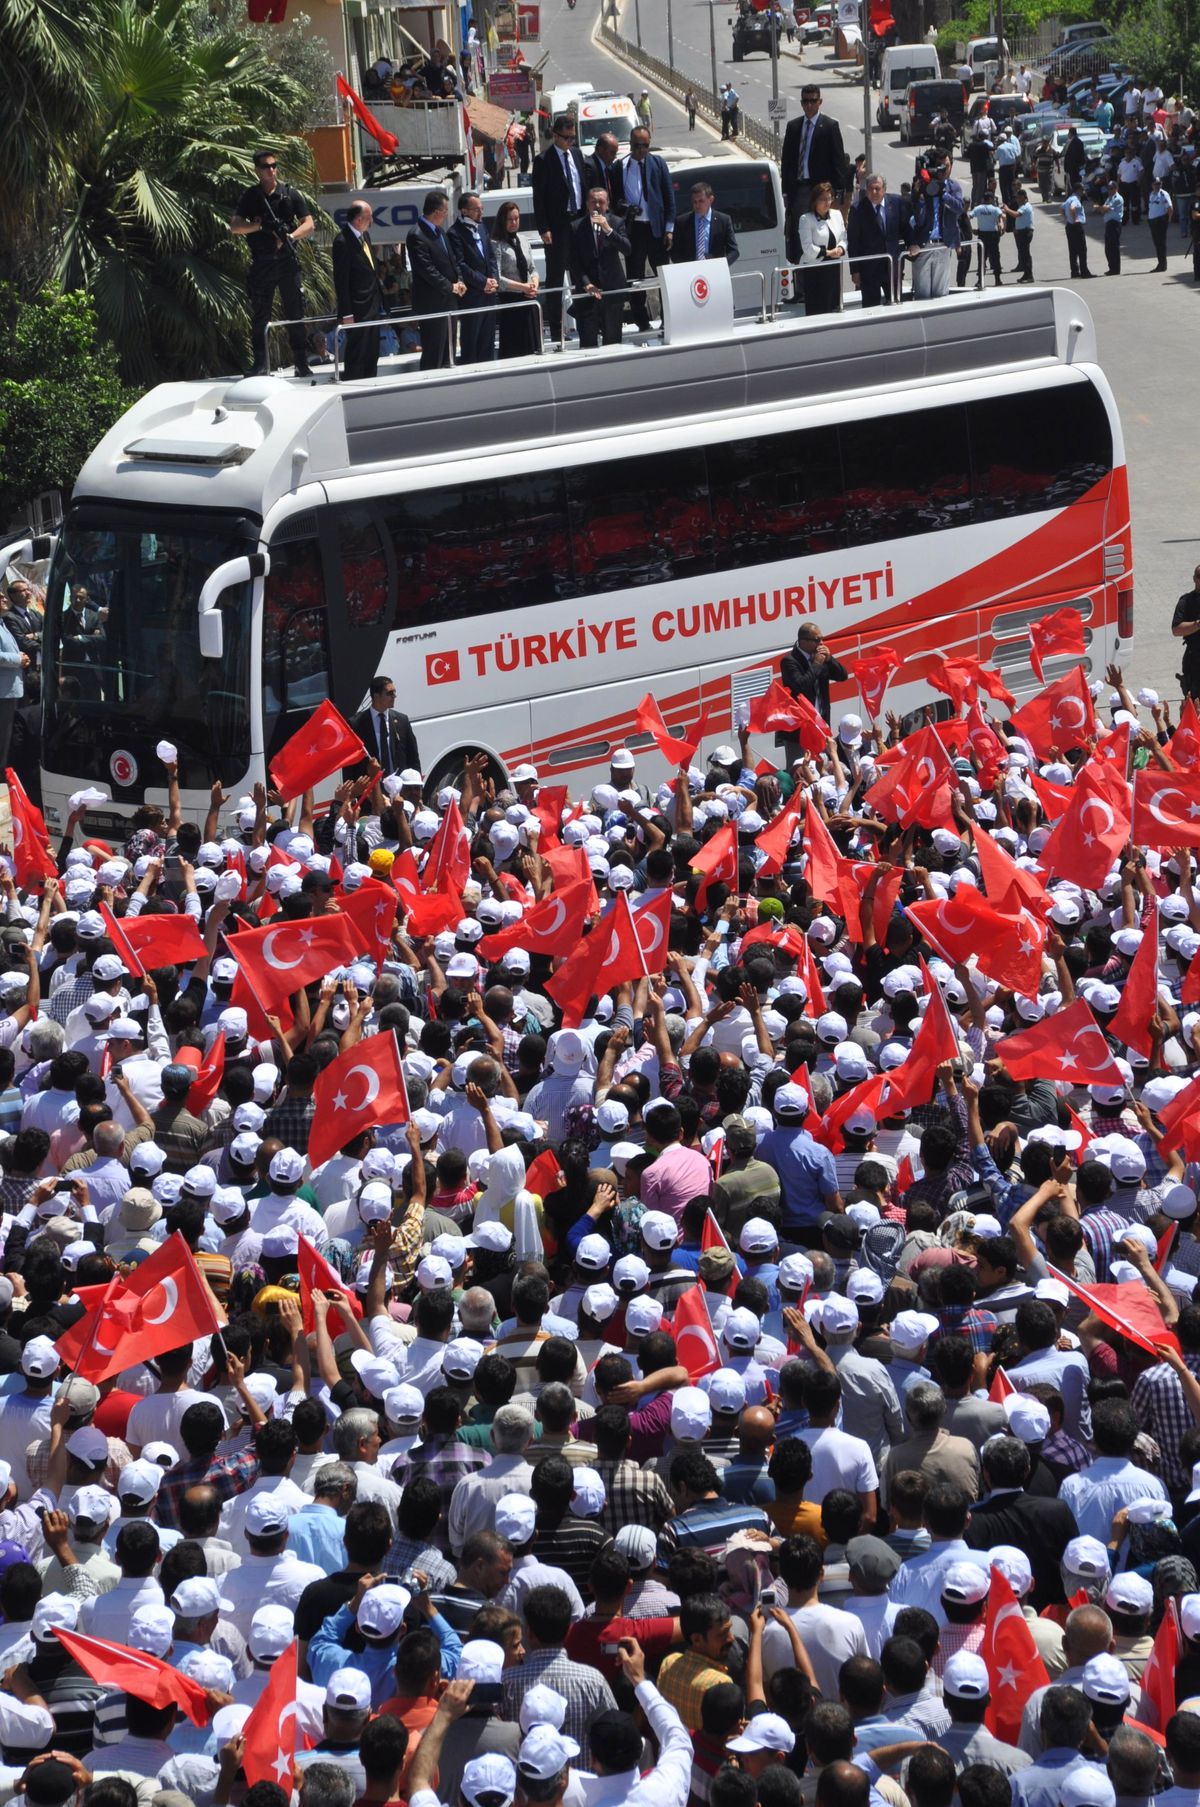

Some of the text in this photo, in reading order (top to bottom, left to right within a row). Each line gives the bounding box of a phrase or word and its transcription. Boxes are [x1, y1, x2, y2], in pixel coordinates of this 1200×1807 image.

[611, 103, 631, 114] 112
[468, 561, 894, 677] TÜRKİYE CUMHURİYETİ
